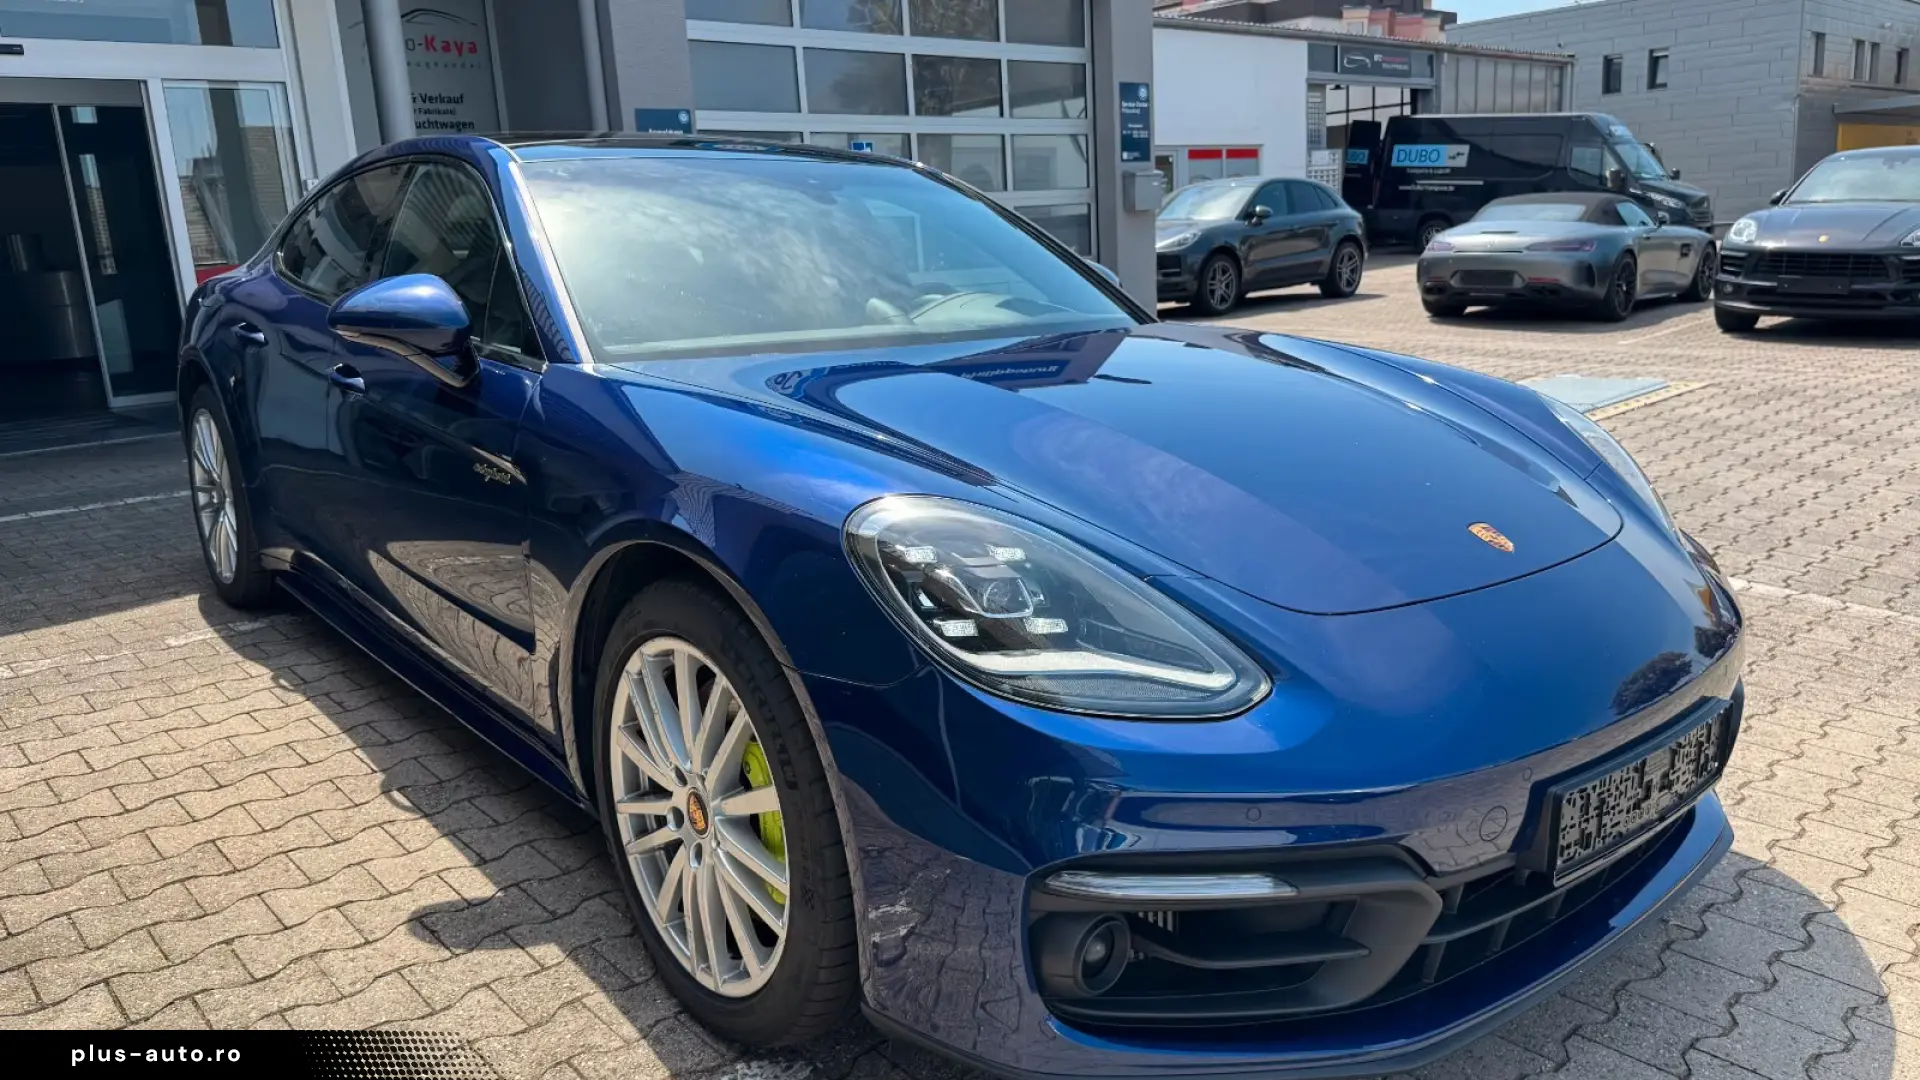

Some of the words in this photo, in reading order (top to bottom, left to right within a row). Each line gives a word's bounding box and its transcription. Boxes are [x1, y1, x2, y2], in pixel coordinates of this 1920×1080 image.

[405, 34, 478, 57] o-Kaya
[419, 92, 464, 104] Verkauf
[414, 118, 476, 132] uchtwagen
[1397, 149, 1441, 163] DUBO
